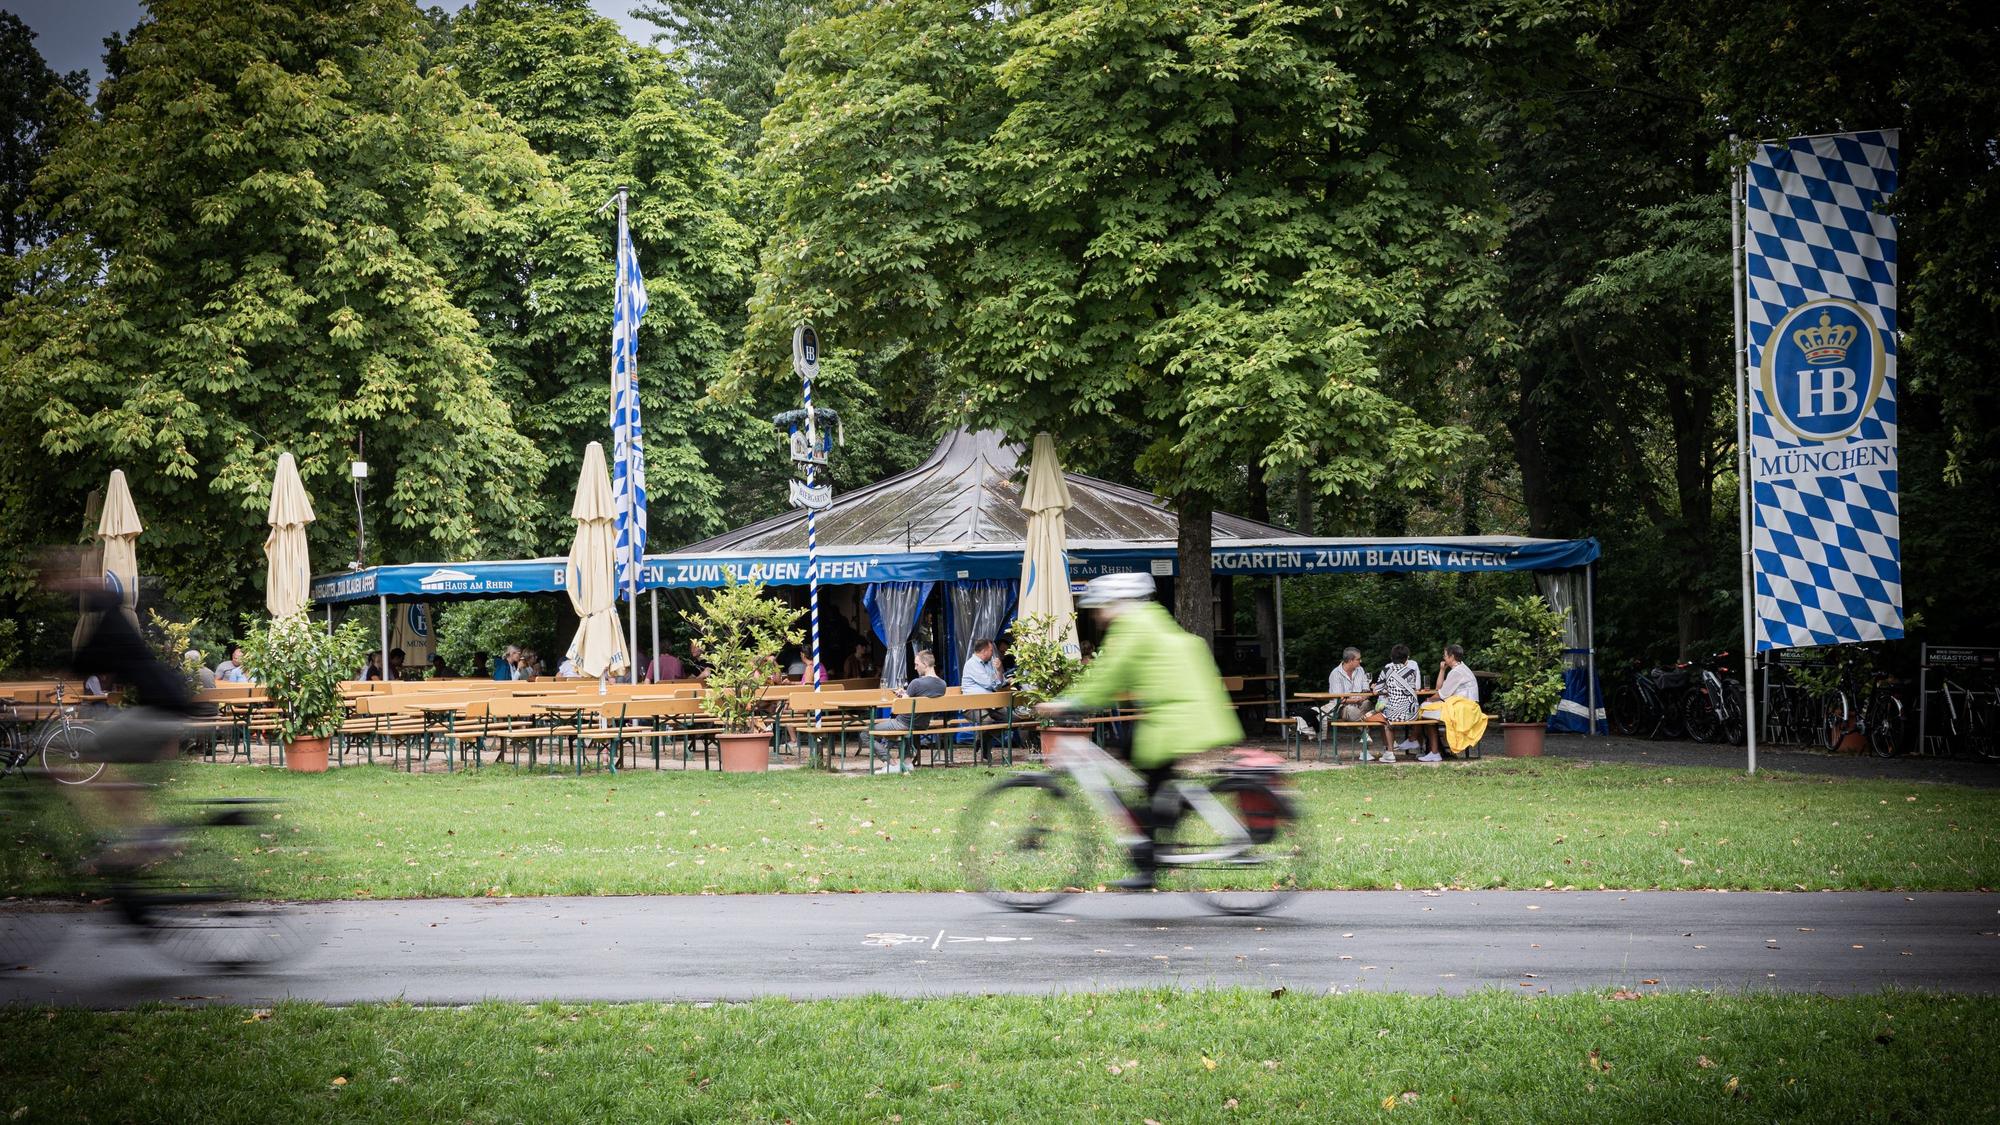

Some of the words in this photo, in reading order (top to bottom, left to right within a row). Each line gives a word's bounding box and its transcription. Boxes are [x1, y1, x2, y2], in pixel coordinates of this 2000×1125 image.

[806, 345, 815, 361] HB
[1796, 367, 1858, 418] HB
[1760, 445, 1892, 477] MÜNCHEN
[1211, 551, 1302, 569] RGARTEN
[1366, 549, 1442, 566] BLAUEN
[1082, 566, 1097, 574] AM
[1101, 565, 1133, 575] RHEIN
[445, 581, 468, 590] HAUS
[470, 582, 483, 590] AM
[486, 580, 513, 589] RHEIN
[1929, 654, 1979, 662] MEGASTORE
